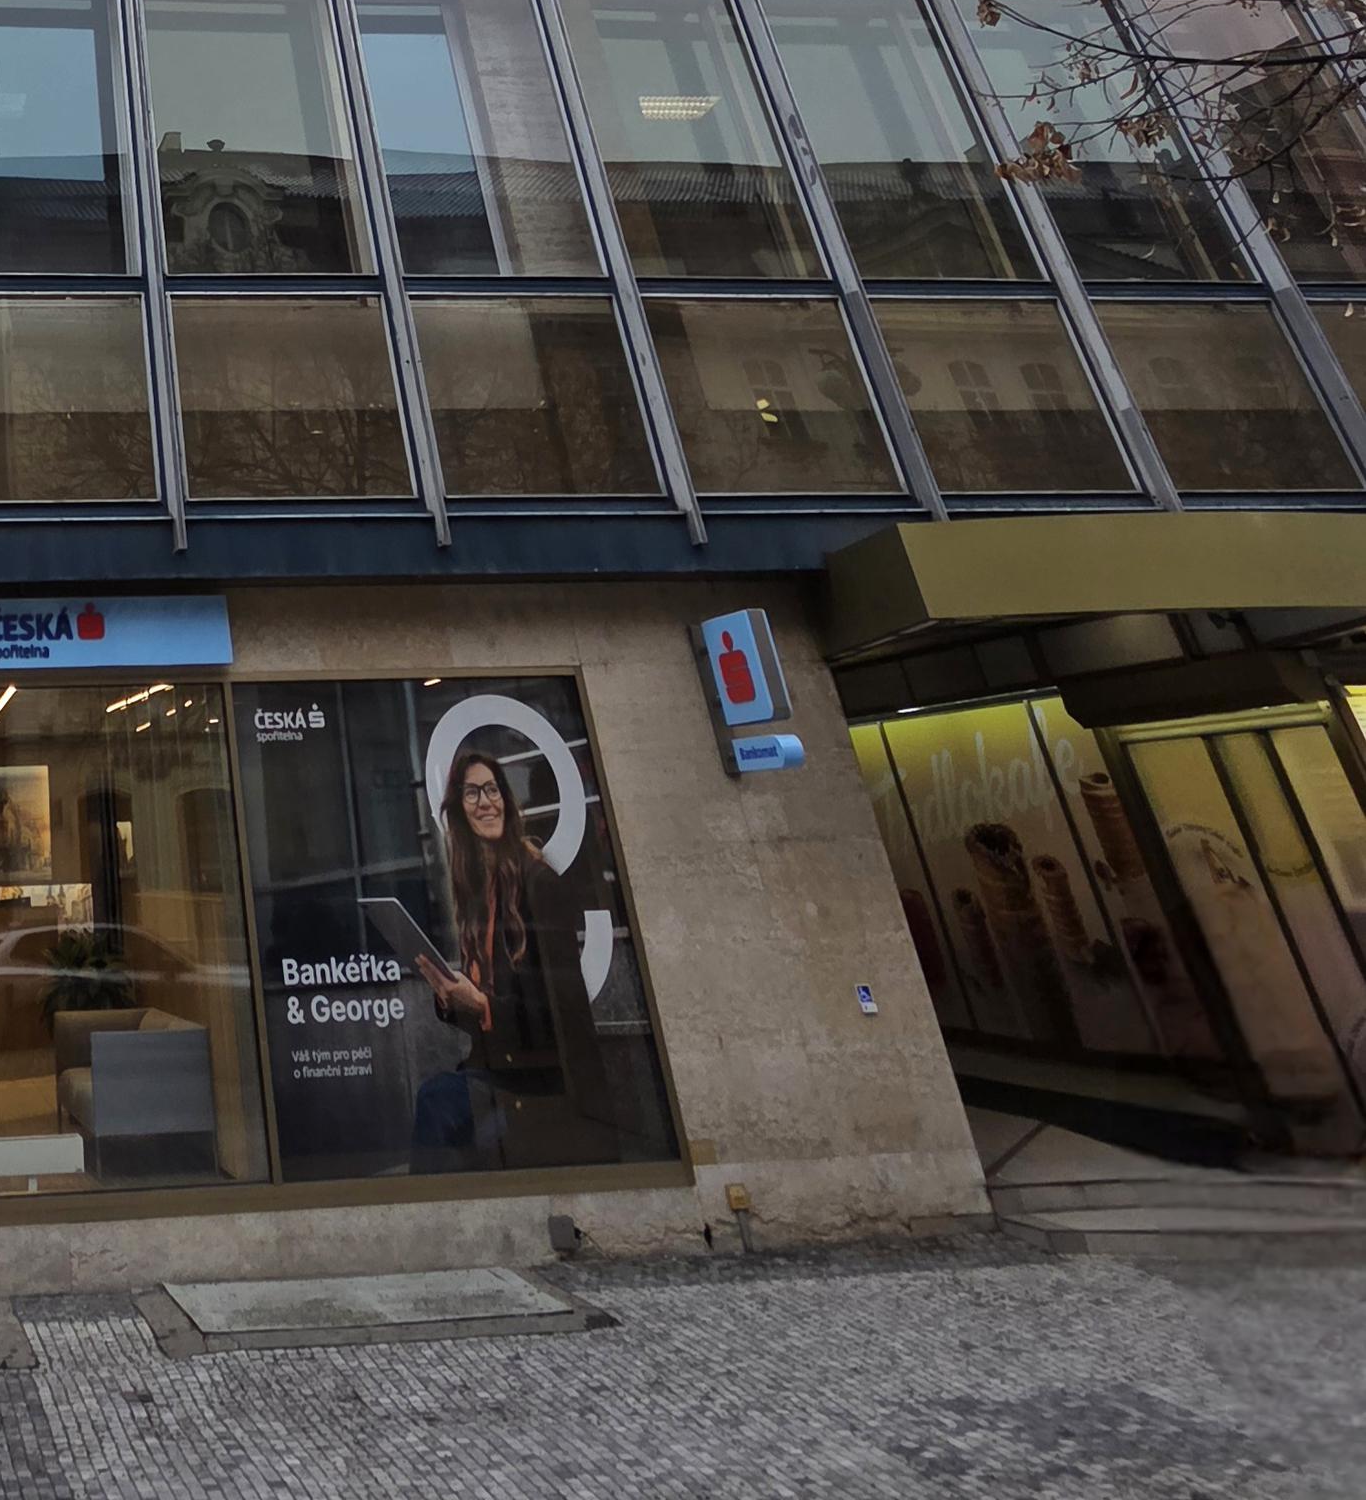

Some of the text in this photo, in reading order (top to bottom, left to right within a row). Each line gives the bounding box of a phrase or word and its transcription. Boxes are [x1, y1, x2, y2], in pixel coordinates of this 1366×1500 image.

[254, 707, 307, 729] ČESKÁ
[281, 953, 401, 986] Bankéřka
[286, 994, 405, 1028] & George
[291, 1049, 311, 1062] Váš
[311, 1049, 332, 1064] tým
[332, 1052, 350, 1063] pro
[302, 1064, 342, 1079] finanční
